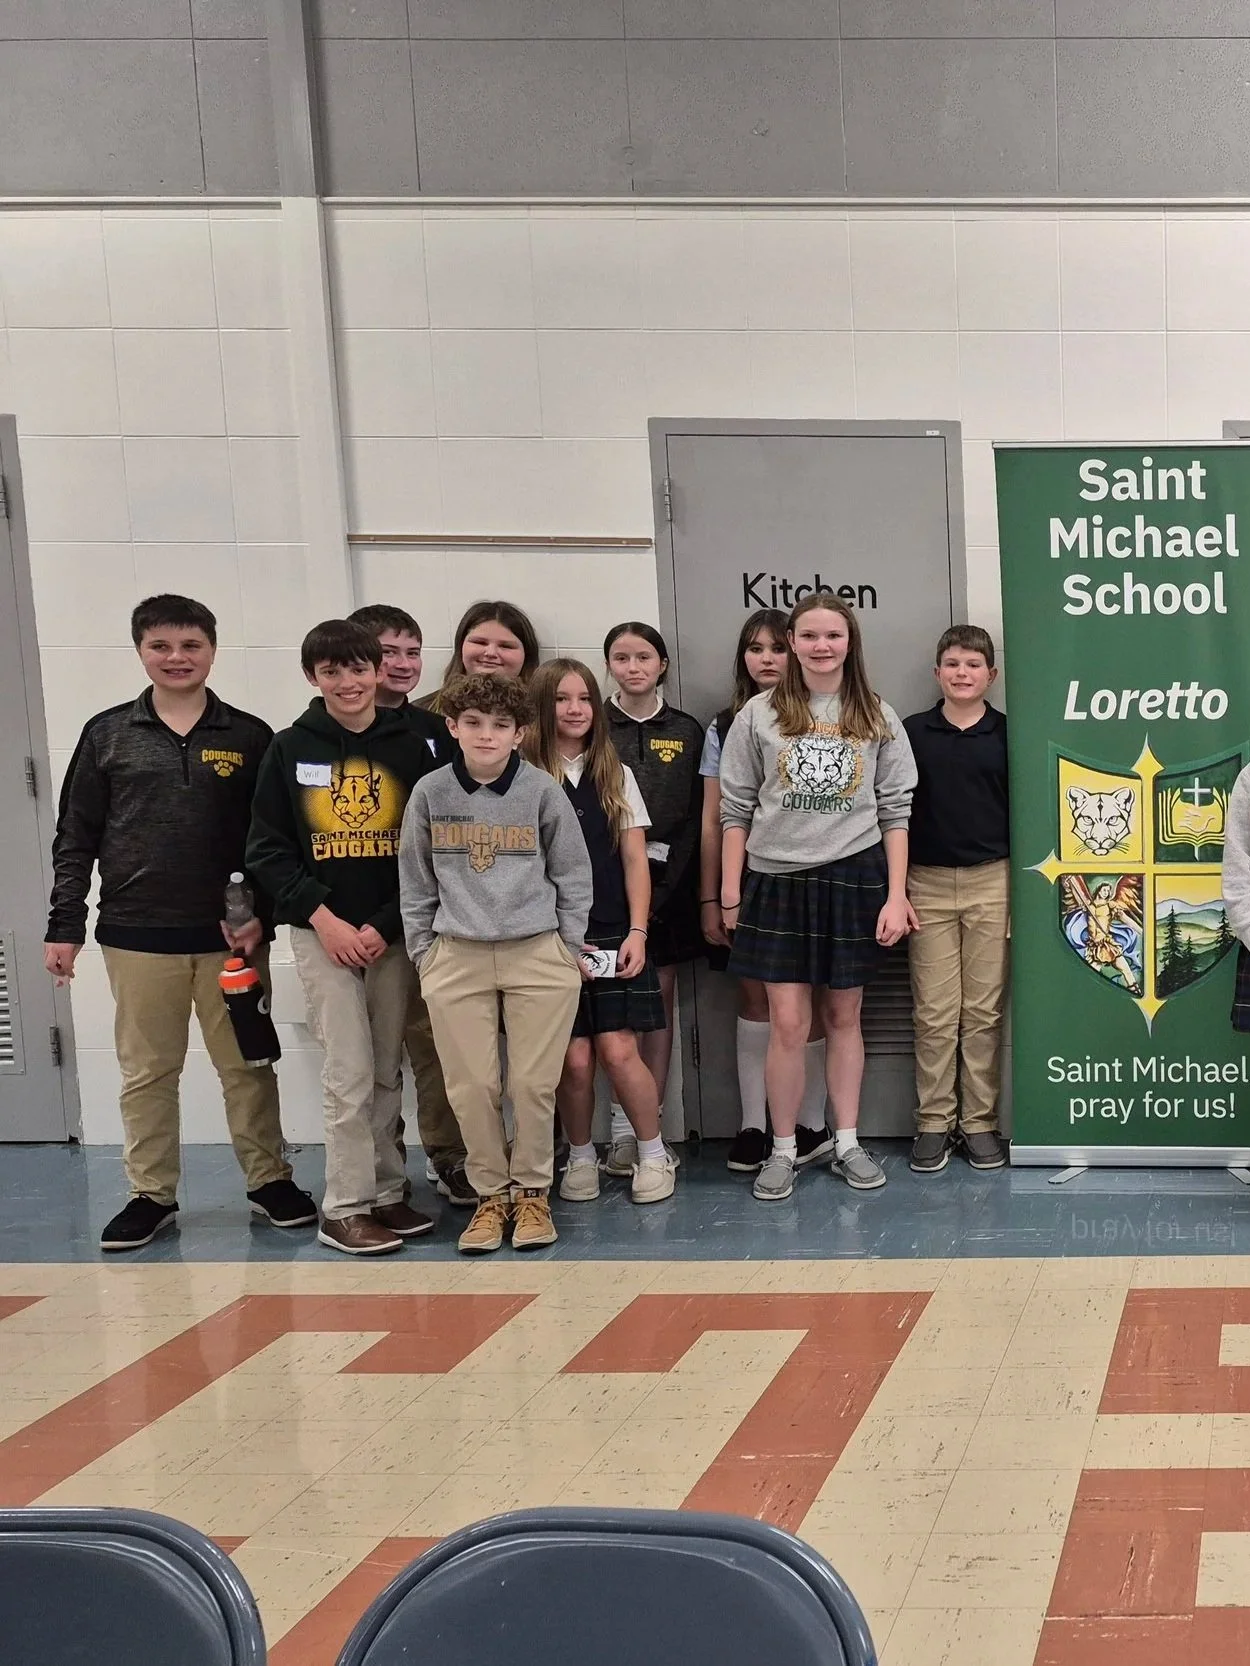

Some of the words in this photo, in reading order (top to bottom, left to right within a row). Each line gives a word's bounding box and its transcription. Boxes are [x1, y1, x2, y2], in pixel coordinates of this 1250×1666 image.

[1079, 456, 1206, 501] Saint
[1050, 514, 1239, 558] Michael
[743, 573, 877, 608] Kitchen
[1063, 571, 1227, 615] School
[1064, 680, 1228, 720] Loretto
[202, 750, 244, 767] COUGARS
[650, 739, 684, 753] COUGARS
[782, 793, 852, 812] COUGARS
[311, 831, 345, 843] SAINT
[431, 823, 536, 849] COUGARS
[1047, 1055, 1122, 1083] Saint
[1069, 1096, 1134, 1125] pray
[1142, 1090, 1184, 1119] for
[1193, 1092, 1235, 1119] us!
